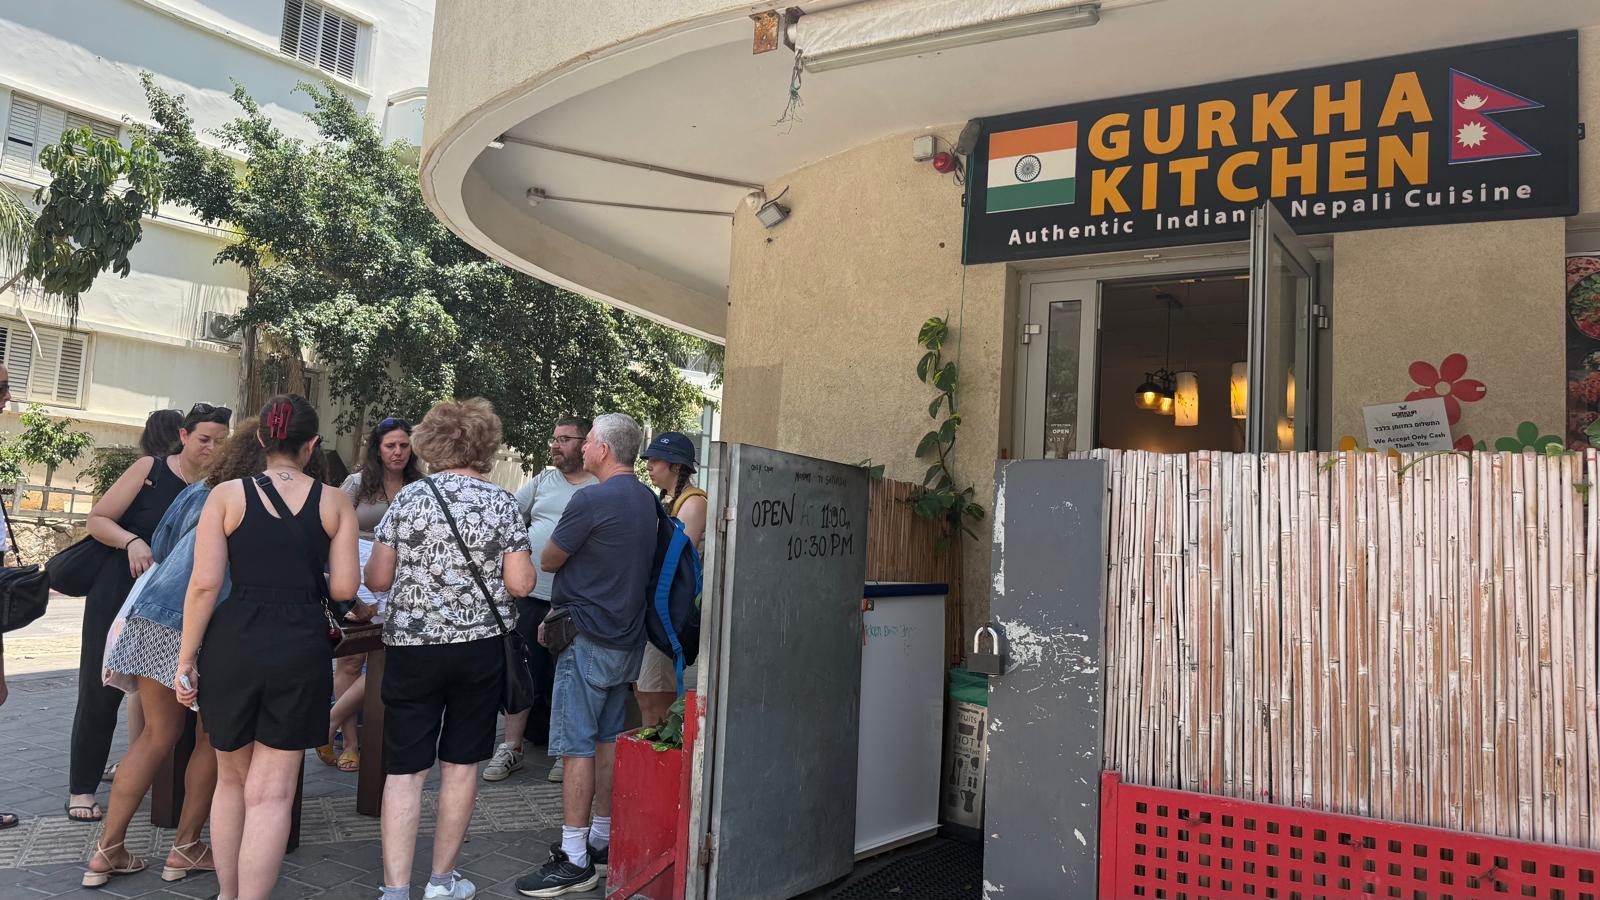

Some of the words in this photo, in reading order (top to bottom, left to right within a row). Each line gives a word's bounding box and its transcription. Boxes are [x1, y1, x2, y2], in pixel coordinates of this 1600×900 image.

[1087, 71, 1434, 161] GURKHA
[1090, 131, 1430, 216] KITCHEN
[1008, 217, 1135, 246] Authentic
[1156, 207, 1247, 231] Indian
[1292, 191, 1393, 219] Nepali
[1404, 181, 1533, 208] Cuisine
[1412, 434, 1427, 442] Only
[752, 493, 797, 528] OPEN
[787, 535, 827, 560] 10:30
[956, 712, 977, 724] Fruits
[954, 735, 976, 746] HOT
